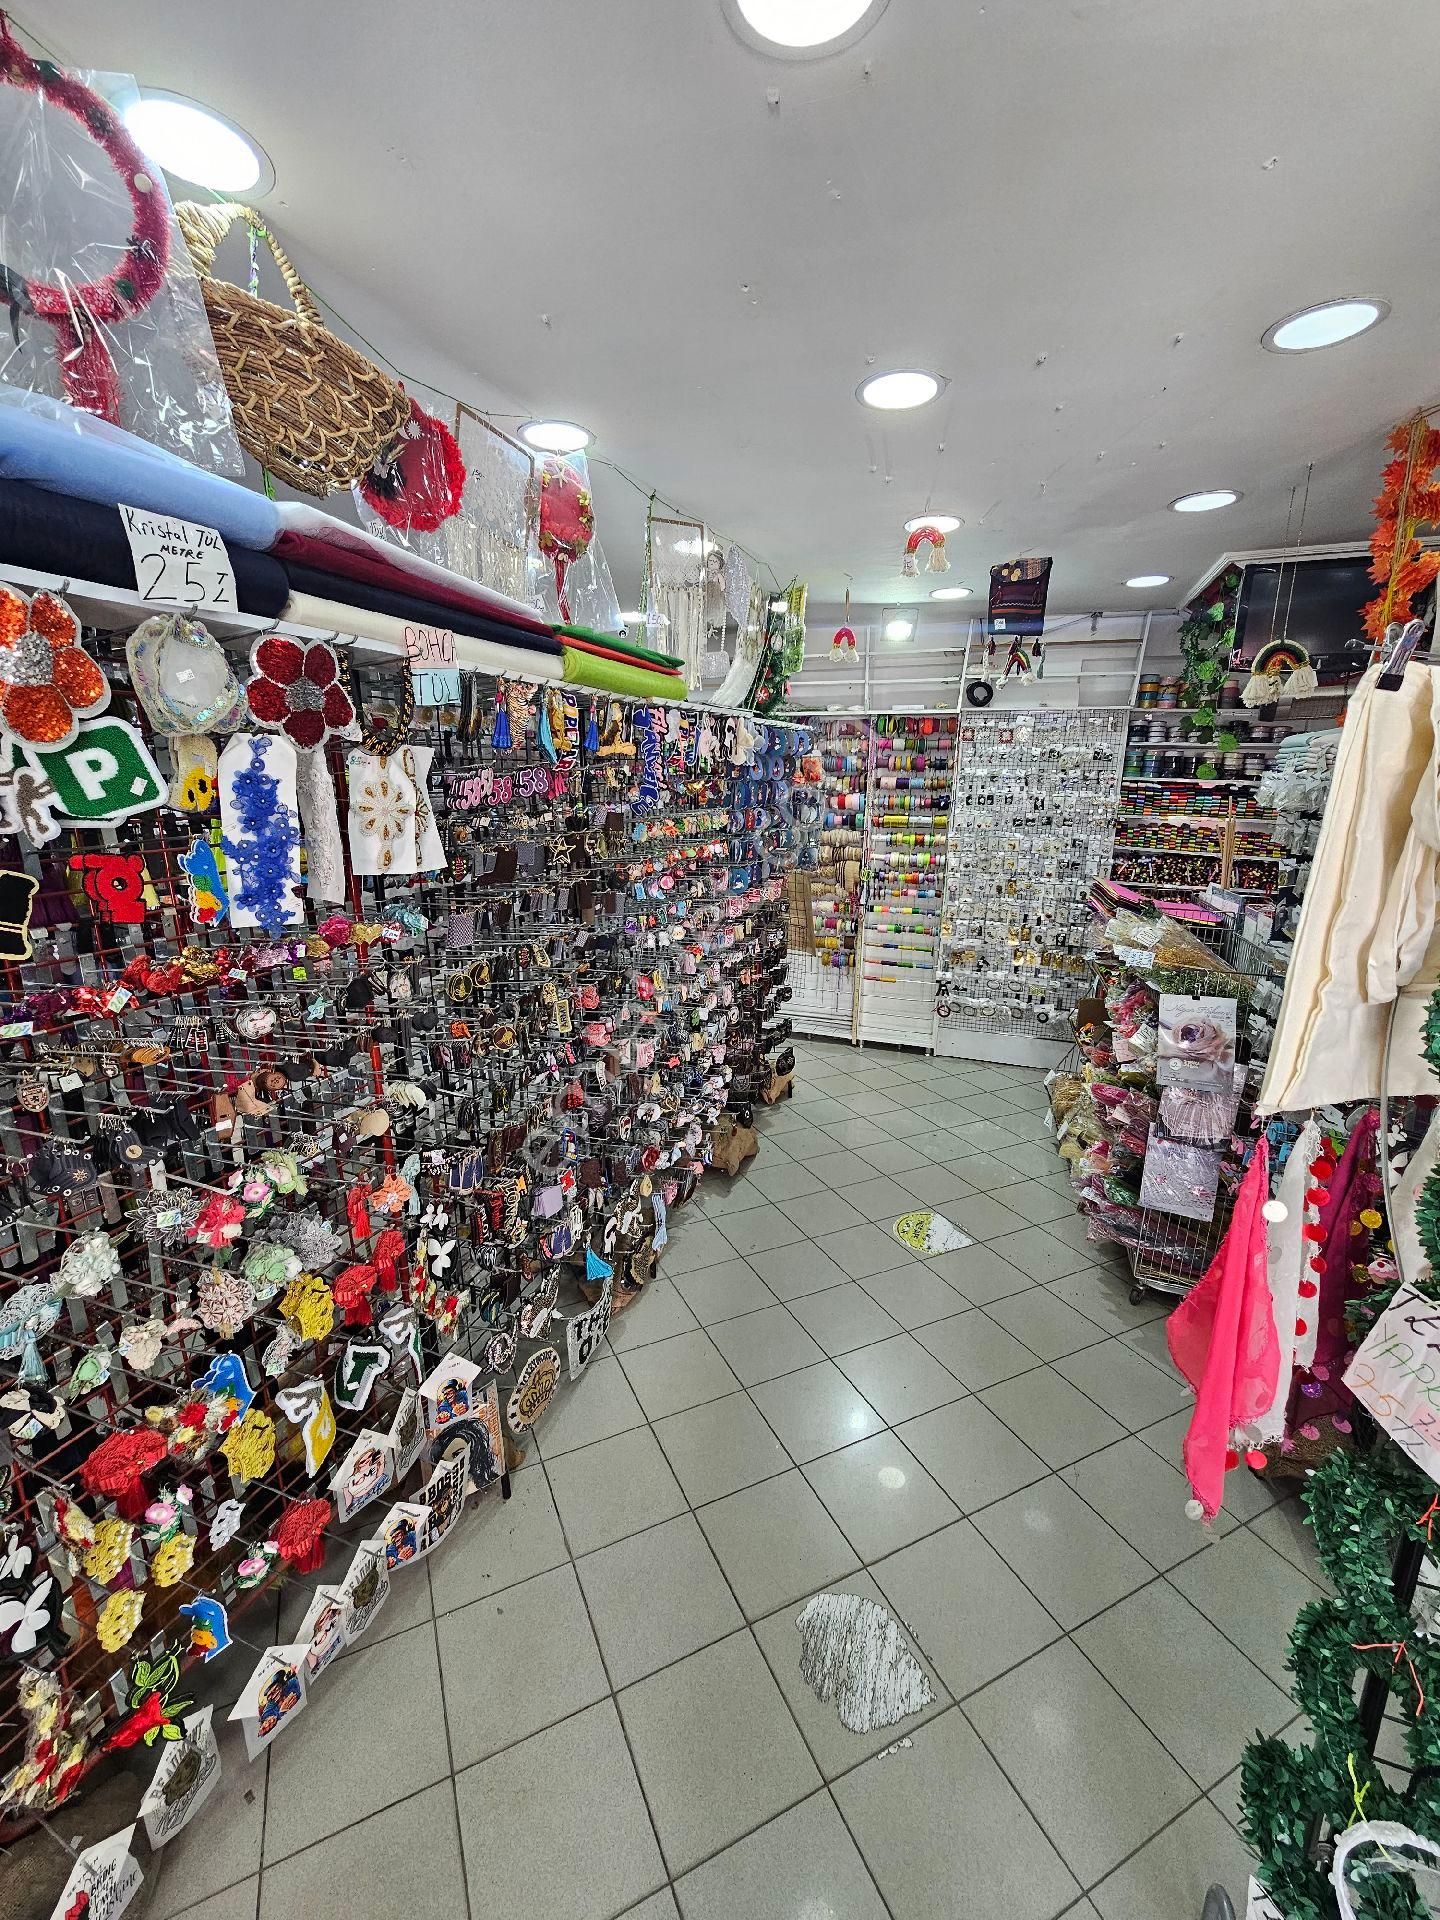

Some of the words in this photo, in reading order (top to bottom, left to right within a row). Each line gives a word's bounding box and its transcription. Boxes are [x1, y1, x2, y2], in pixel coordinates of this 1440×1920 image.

[124, 507, 189, 545] Kristal
[160, 544, 204, 560] METRE
[140, 553, 206, 602] 25
[65, 747, 119, 801] P
[488, 776, 513, 806] 58
[518, 767, 549, 797] 58
